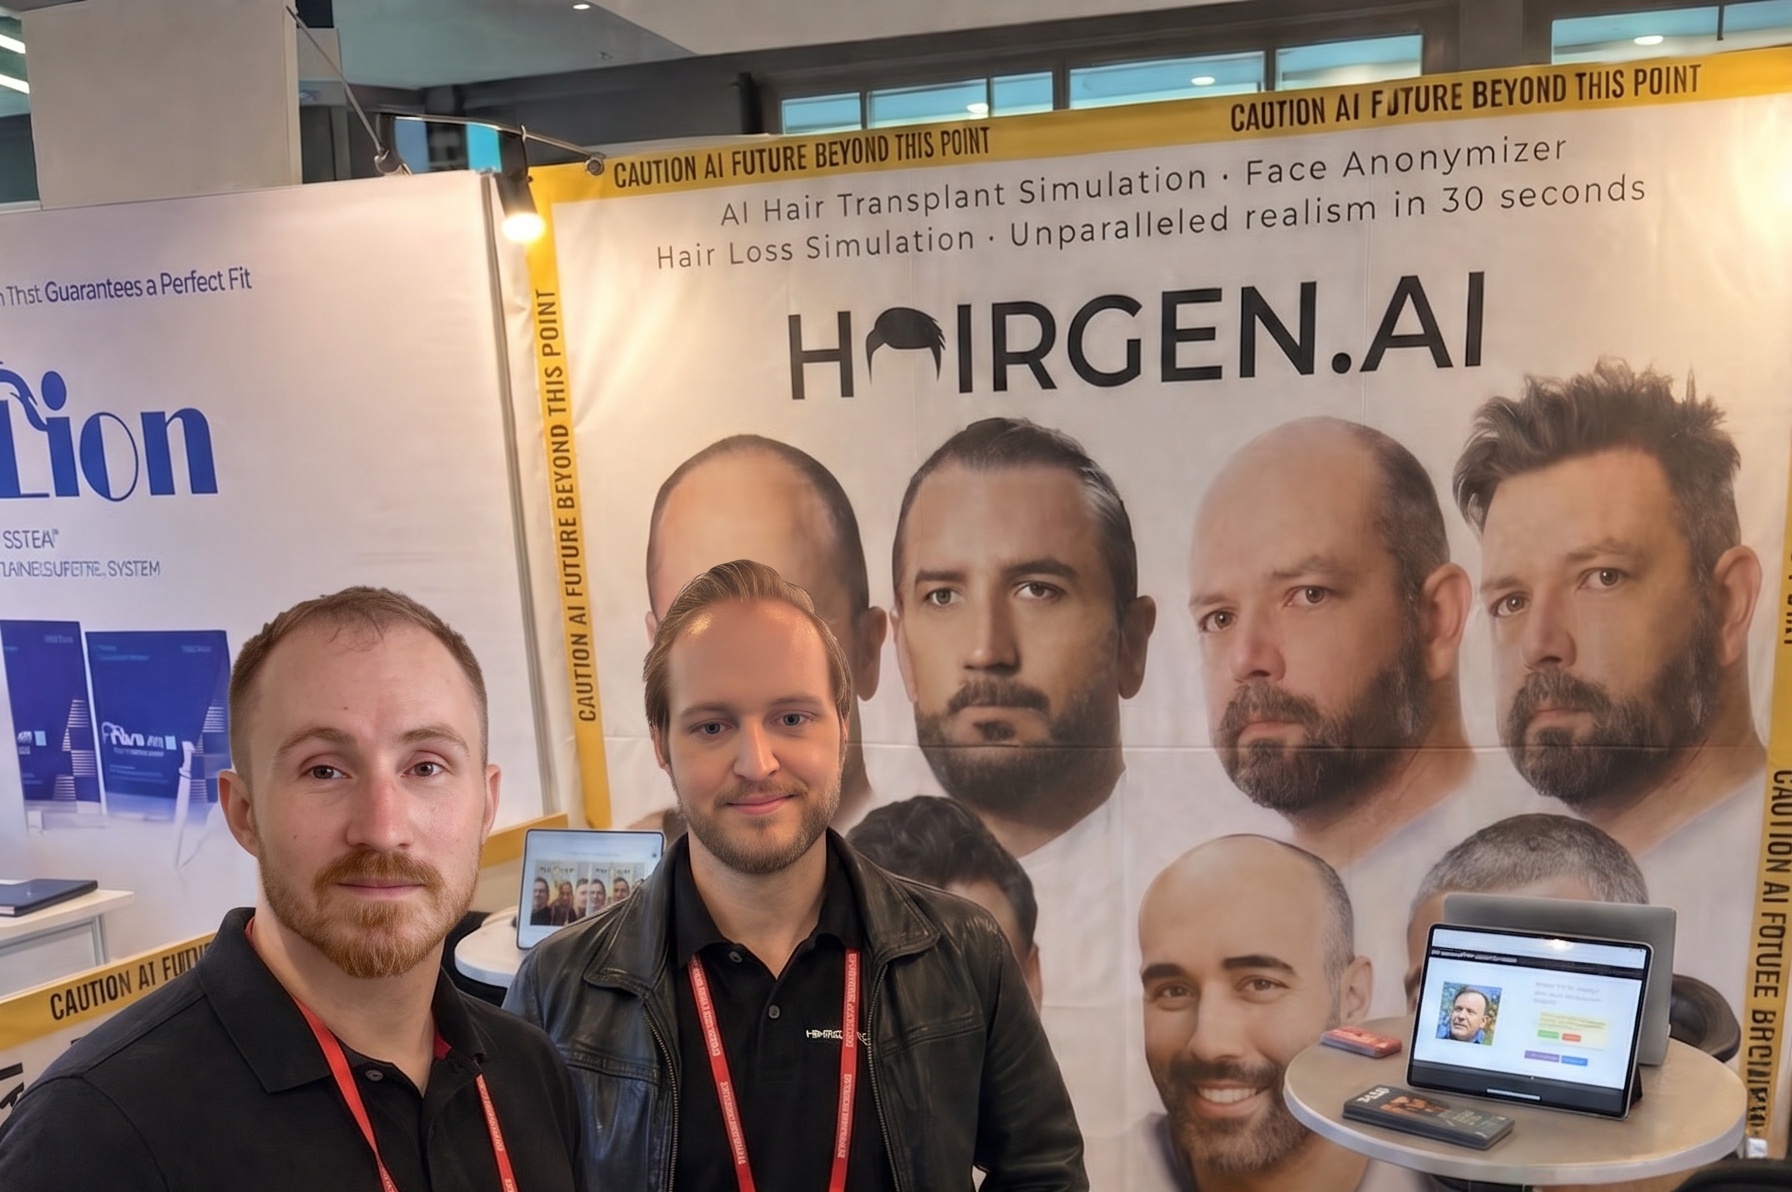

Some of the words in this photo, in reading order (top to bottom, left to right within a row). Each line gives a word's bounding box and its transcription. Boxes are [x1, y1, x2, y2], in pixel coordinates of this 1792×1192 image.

[1231, 95, 1325, 132] CAUTION
[1335, 92, 1360, 120] AI
[1472, 74, 1566, 109] BEYOND
[1575, 68, 1625, 101] THIS
[1633, 64, 1702, 96] POINT
[613, 155, 697, 189] CAUTION
[704, 157, 724, 179] AI
[732, 142, 807, 175] FUTURE
[815, 133, 889, 169] BEYOND
[896, 130, 935, 161] THIS
[941, 126, 990, 155] POINT
[721, 201, 748, 226] AI
[764, 194, 824, 222] Hair
[837, 182, 1005, 218] Transplant
[1019, 166, 1207, 203] Simulation
[1246, 157, 1327, 186] Face
[1342, 135, 1567, 178] Anonymizer
[657, 240, 716, 270] Hair
[730, 238, 794, 265] Loss
[806, 226, 975, 259] Simulation
[1010, 205, 1229, 251] Unparalleled
[1245, 194, 1377, 231] realism
[1394, 187, 1426, 218] in
[1441, 185, 1485, 213] 30
[1500, 173, 1646, 209] seconds
[44, 278, 143, 303] Guarantees
[146, 279, 157, 296] a
[160, 269, 226, 295] Perfect
[229, 266, 253, 290] Fit
[535, 288, 562, 358] POINT
[544, 365, 567, 417] THIS
[550, 423, 575, 510] BEYOND
[559, 516, 583, 597] FUTURE
[568, 605, 587, 626] AI
[570, 632, 597, 723] CAUTION
[1763, 881, 1790, 902] AI
[50, 969, 132, 1021] CAUTION
